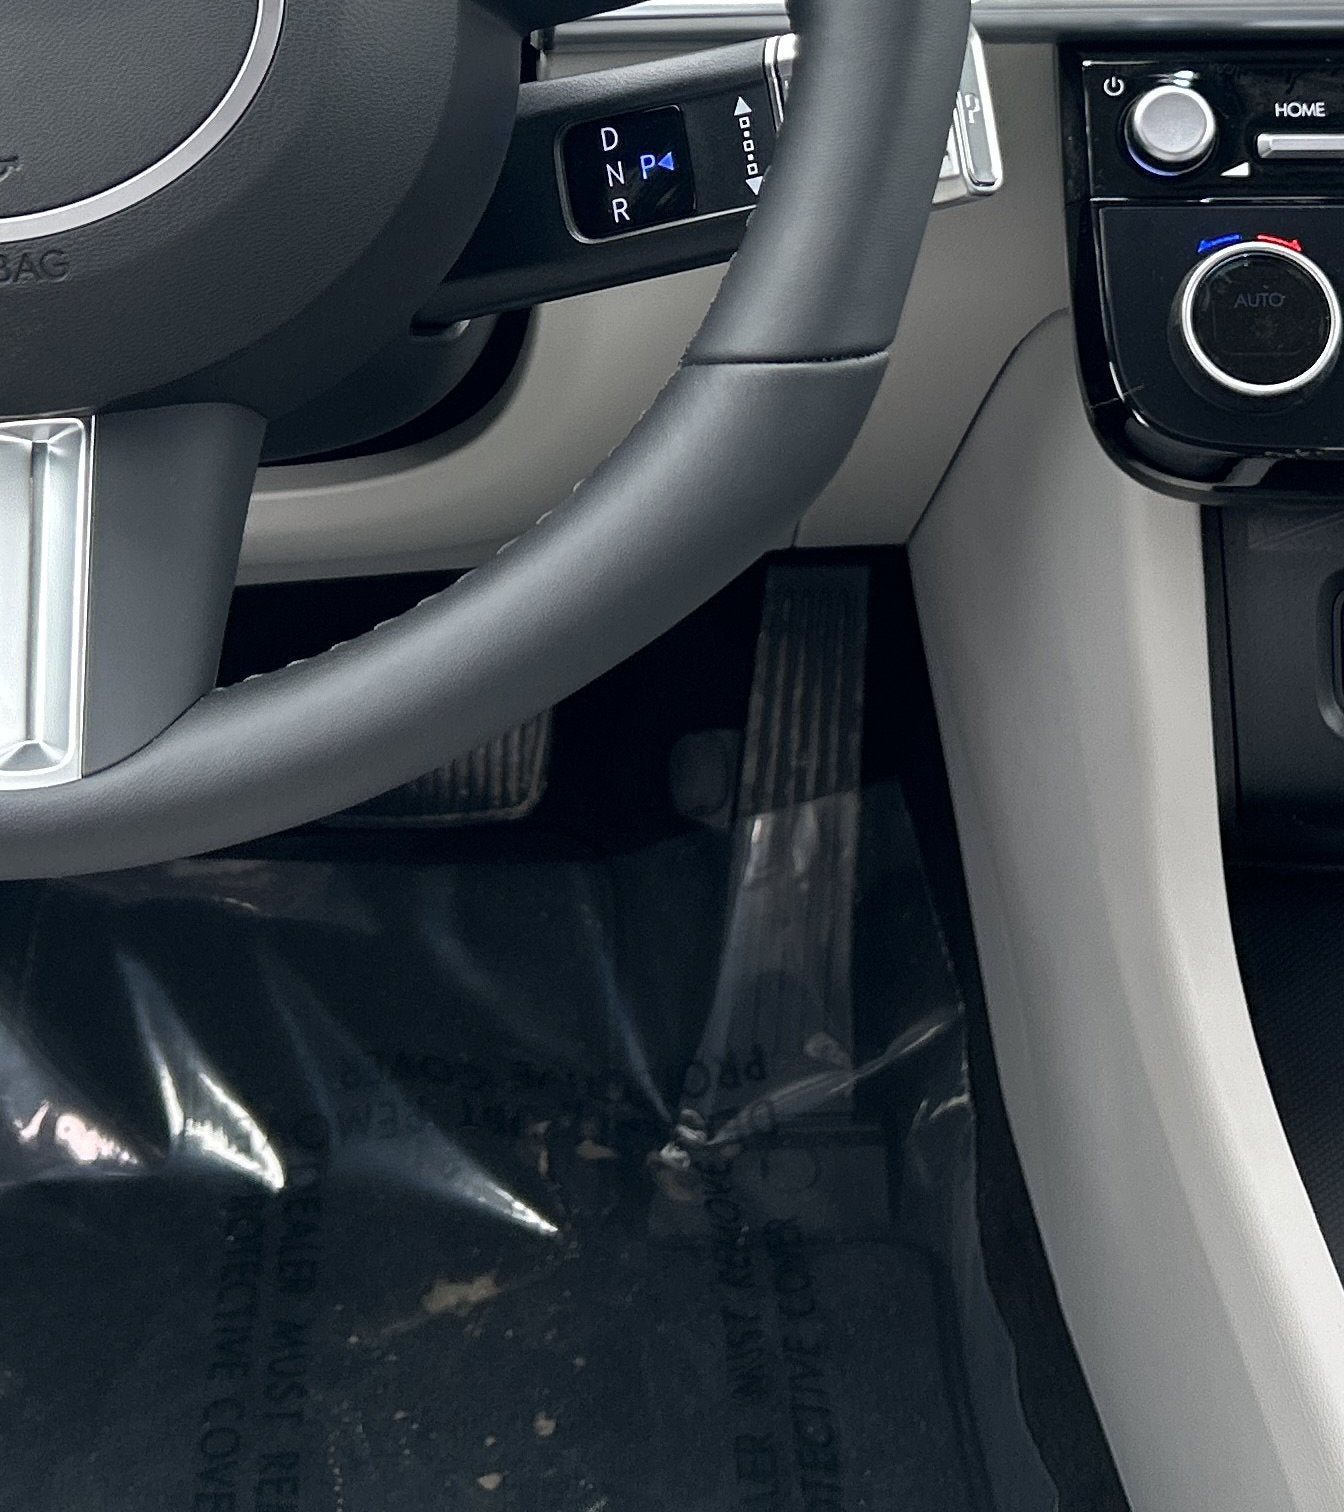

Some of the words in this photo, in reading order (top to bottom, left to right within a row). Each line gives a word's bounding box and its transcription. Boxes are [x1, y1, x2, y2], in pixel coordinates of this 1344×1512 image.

[1275, 102, 1325, 117] HOME
[601, 127, 618, 151] D
[606, 161, 624, 187] N
[640, 155, 655, 179] P
[612, 198, 630, 223] R
[1234, 292, 1286, 308] AUTO
[262, 1319, 315, 1426] MUST
